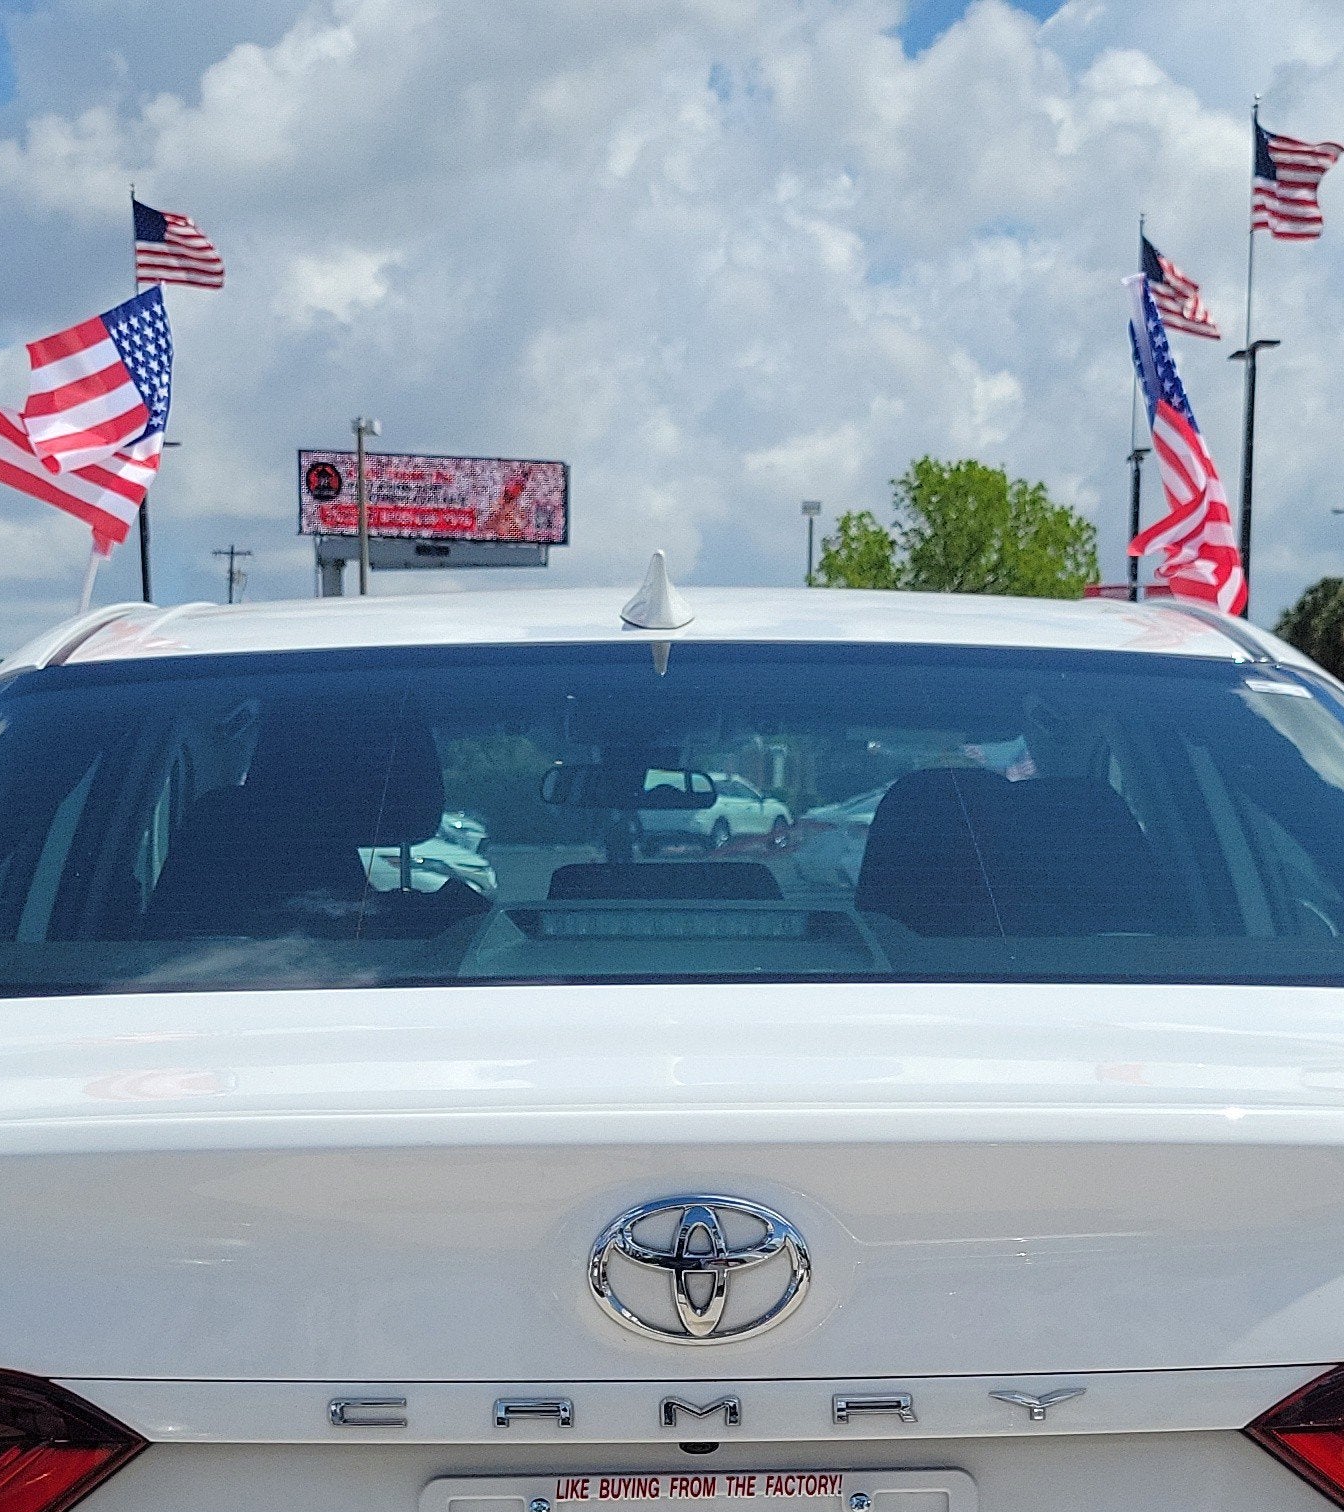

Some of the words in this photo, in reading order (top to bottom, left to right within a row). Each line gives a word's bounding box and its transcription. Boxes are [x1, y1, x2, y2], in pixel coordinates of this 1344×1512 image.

[327, 1386, 1088, 1429] CAMRY
[556, 1478, 589, 1500] LIKE
[599, 1477, 661, 1500] BUYING
[669, 1476, 717, 1498] FROM
[726, 1475, 757, 1498] THE
[765, 1474, 844, 1497] FACTORY!
